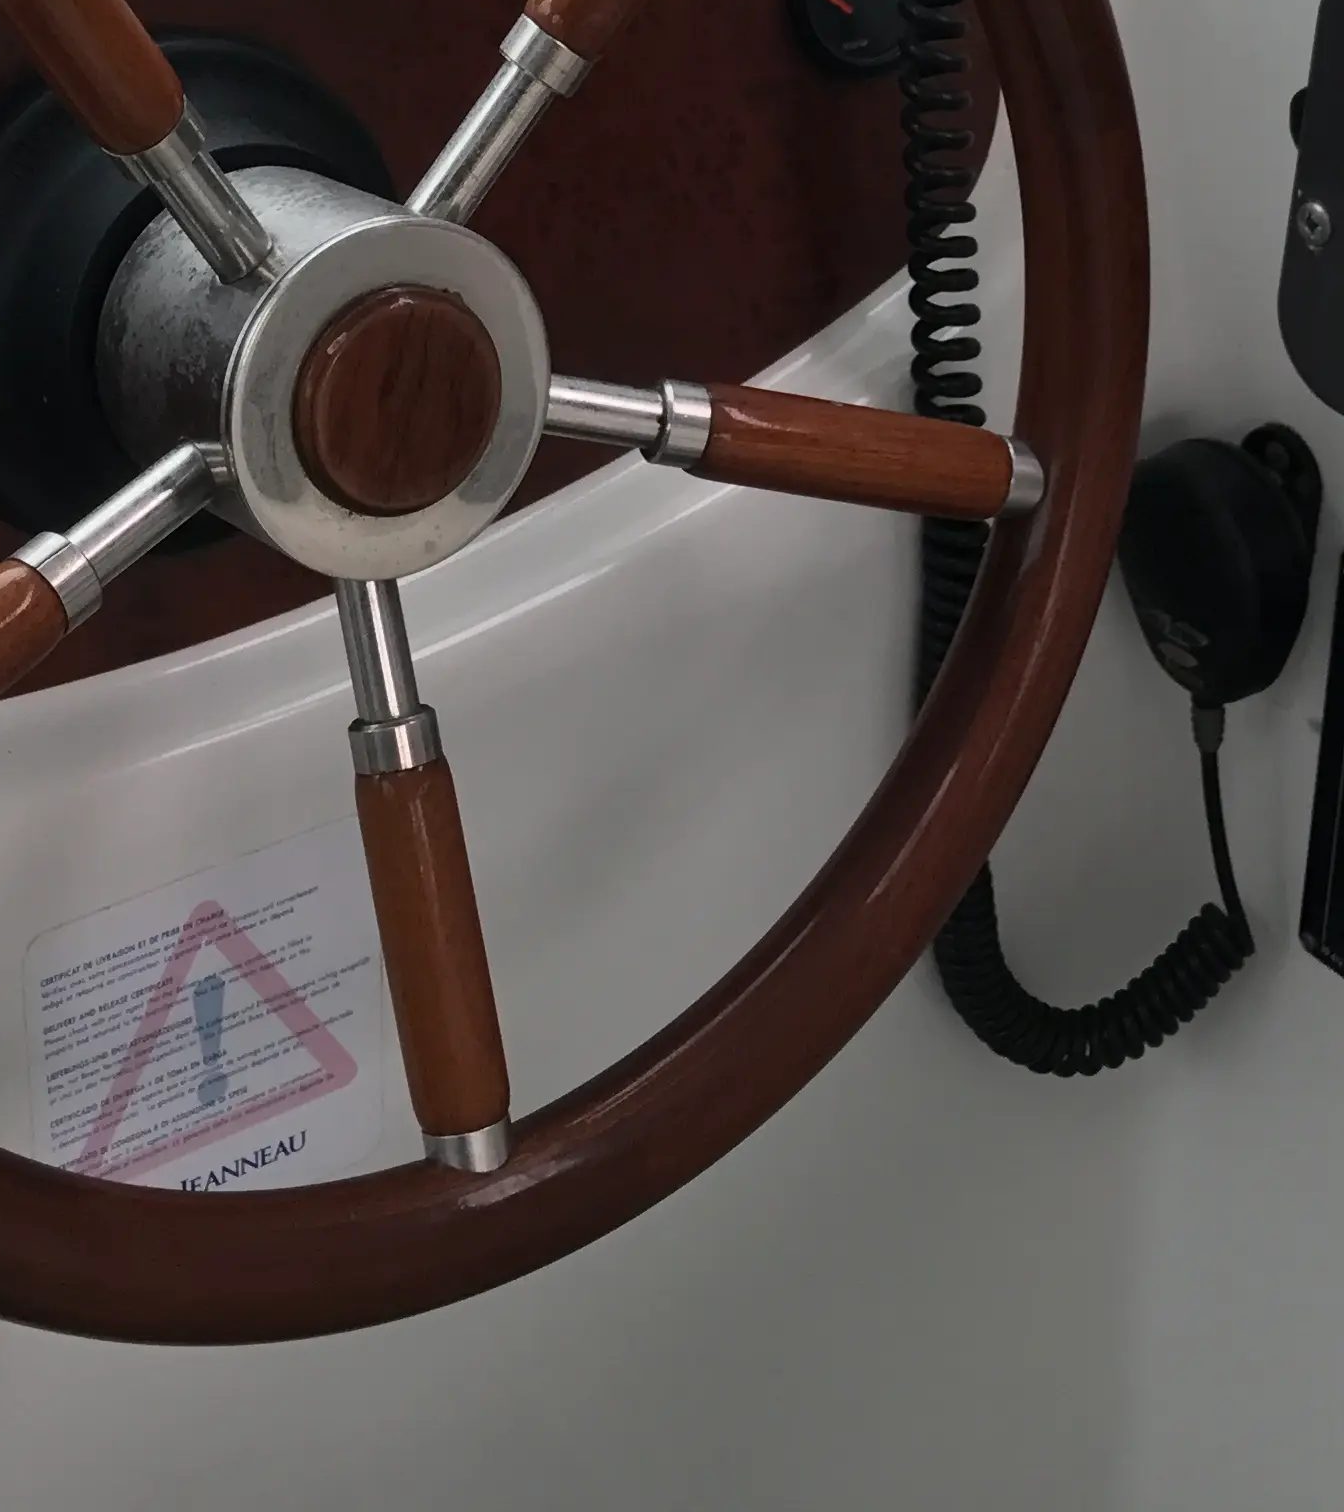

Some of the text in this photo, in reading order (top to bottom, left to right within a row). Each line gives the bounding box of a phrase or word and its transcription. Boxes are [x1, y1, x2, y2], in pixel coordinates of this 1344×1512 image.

[40, 964, 79, 988] CERTIFICAT
[43, 1015, 75, 1036] DELIVERY
[78, 1007, 96, 1021] AND
[98, 994, 127, 1014] RELEASE
[181, 1129, 307, 1192] JEANNEAU
